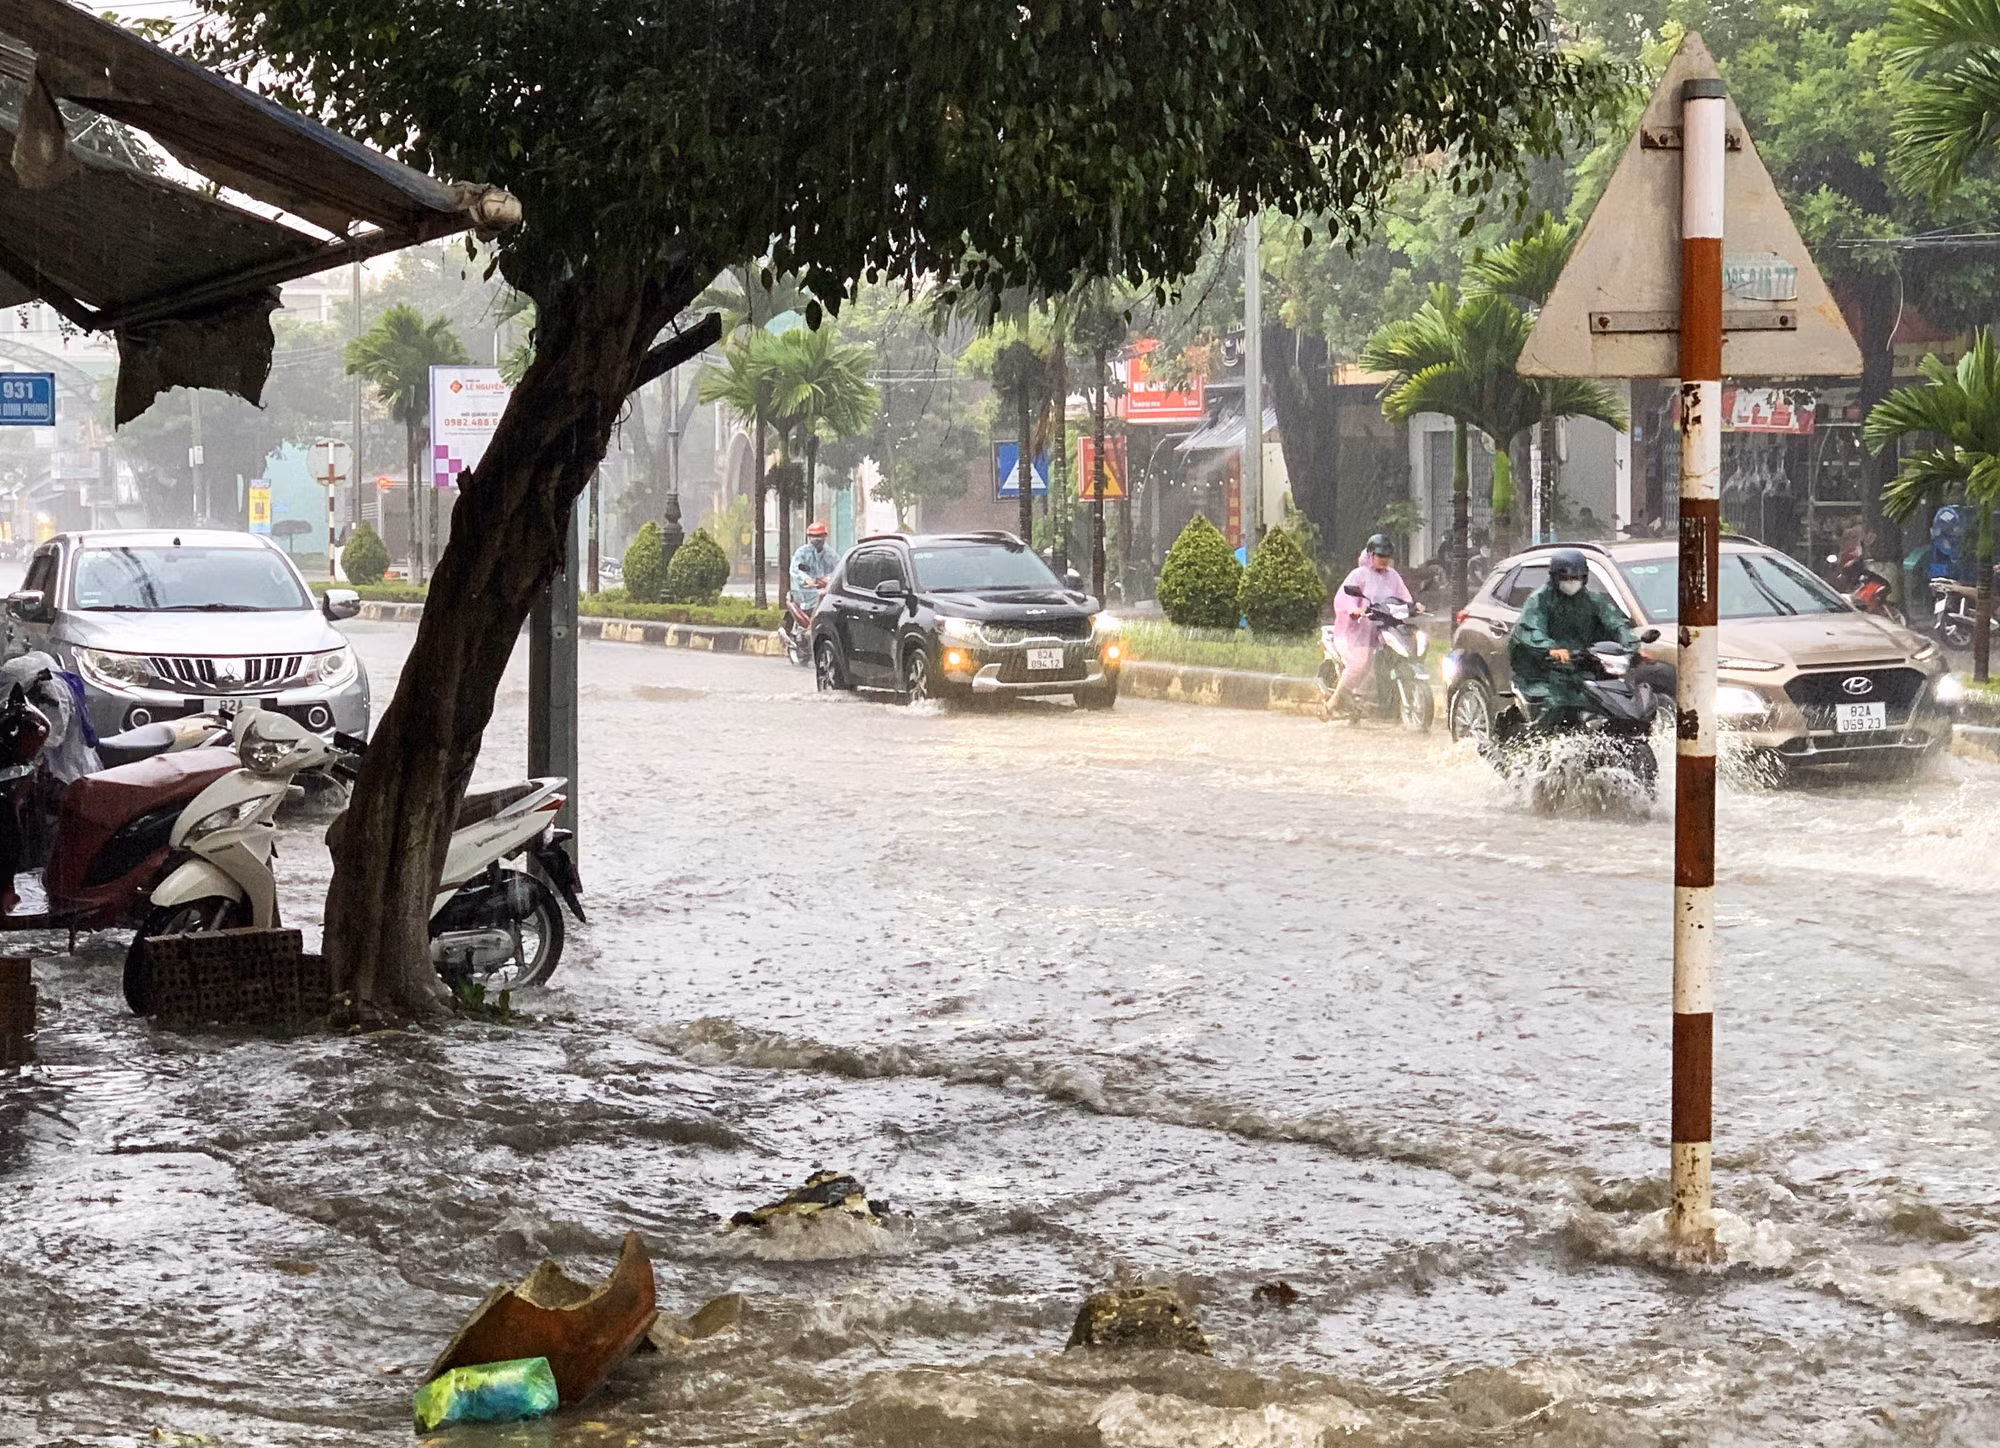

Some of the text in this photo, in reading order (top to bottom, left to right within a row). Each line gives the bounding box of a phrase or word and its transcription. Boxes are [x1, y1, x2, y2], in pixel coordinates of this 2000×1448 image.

[3, 381, 33, 399] 931
[444, 418, 498, 427] 0982.488.6
[1037, 650, 1053, 659] 82A
[220, 699, 244, 713] 82A
[1850, 704, 1872, 717] 82A
[1842, 717, 1881, 731] 069.23
